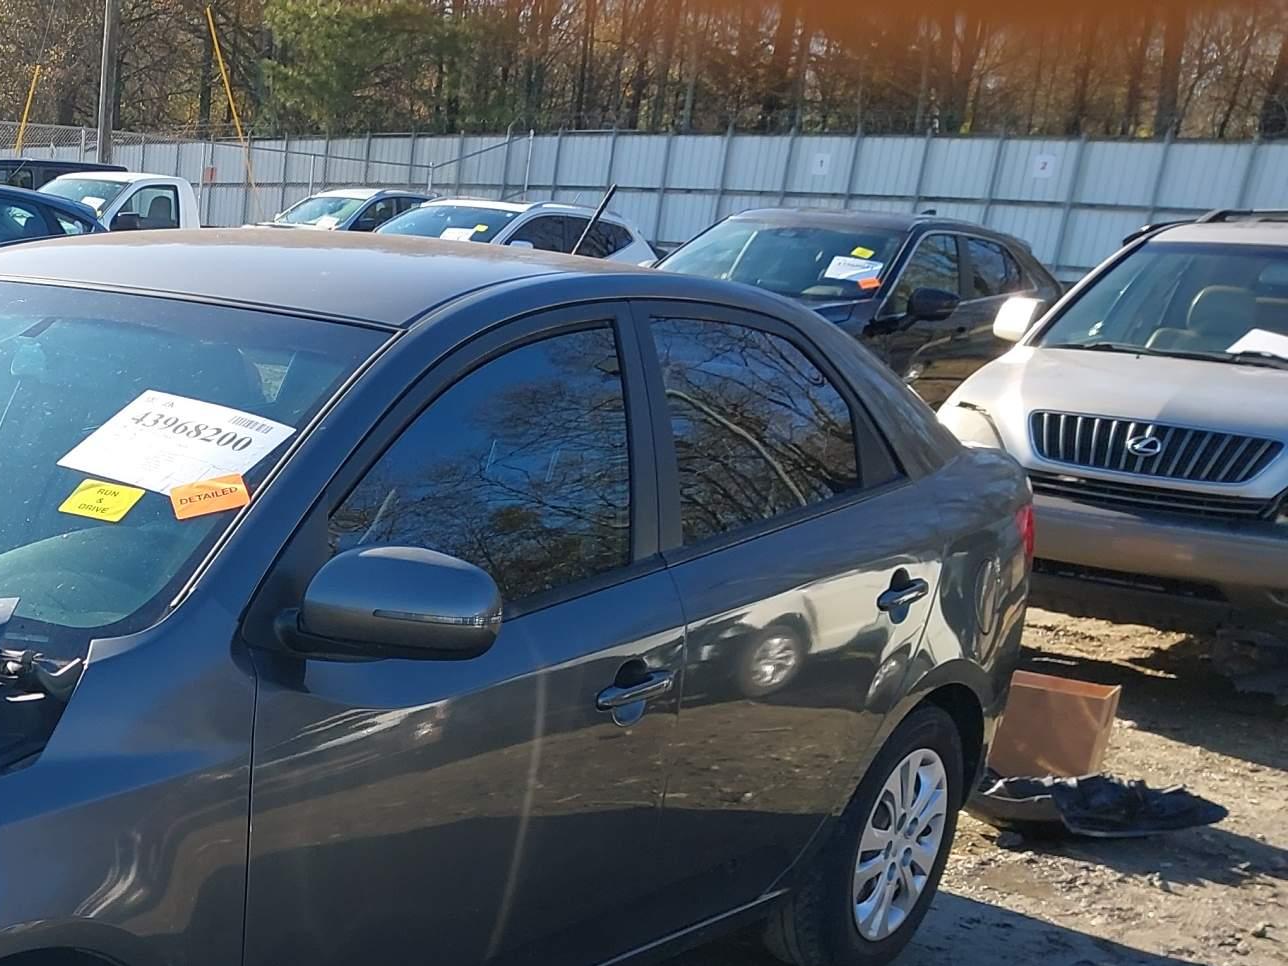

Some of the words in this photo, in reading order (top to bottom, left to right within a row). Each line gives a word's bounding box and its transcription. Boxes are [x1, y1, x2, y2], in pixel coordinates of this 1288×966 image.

[131, 411, 253, 452] 43968200
[96, 488, 120, 497] RUN
[179, 486, 239, 505] DETAILED
[77, 503, 110, 514] DRIVE
